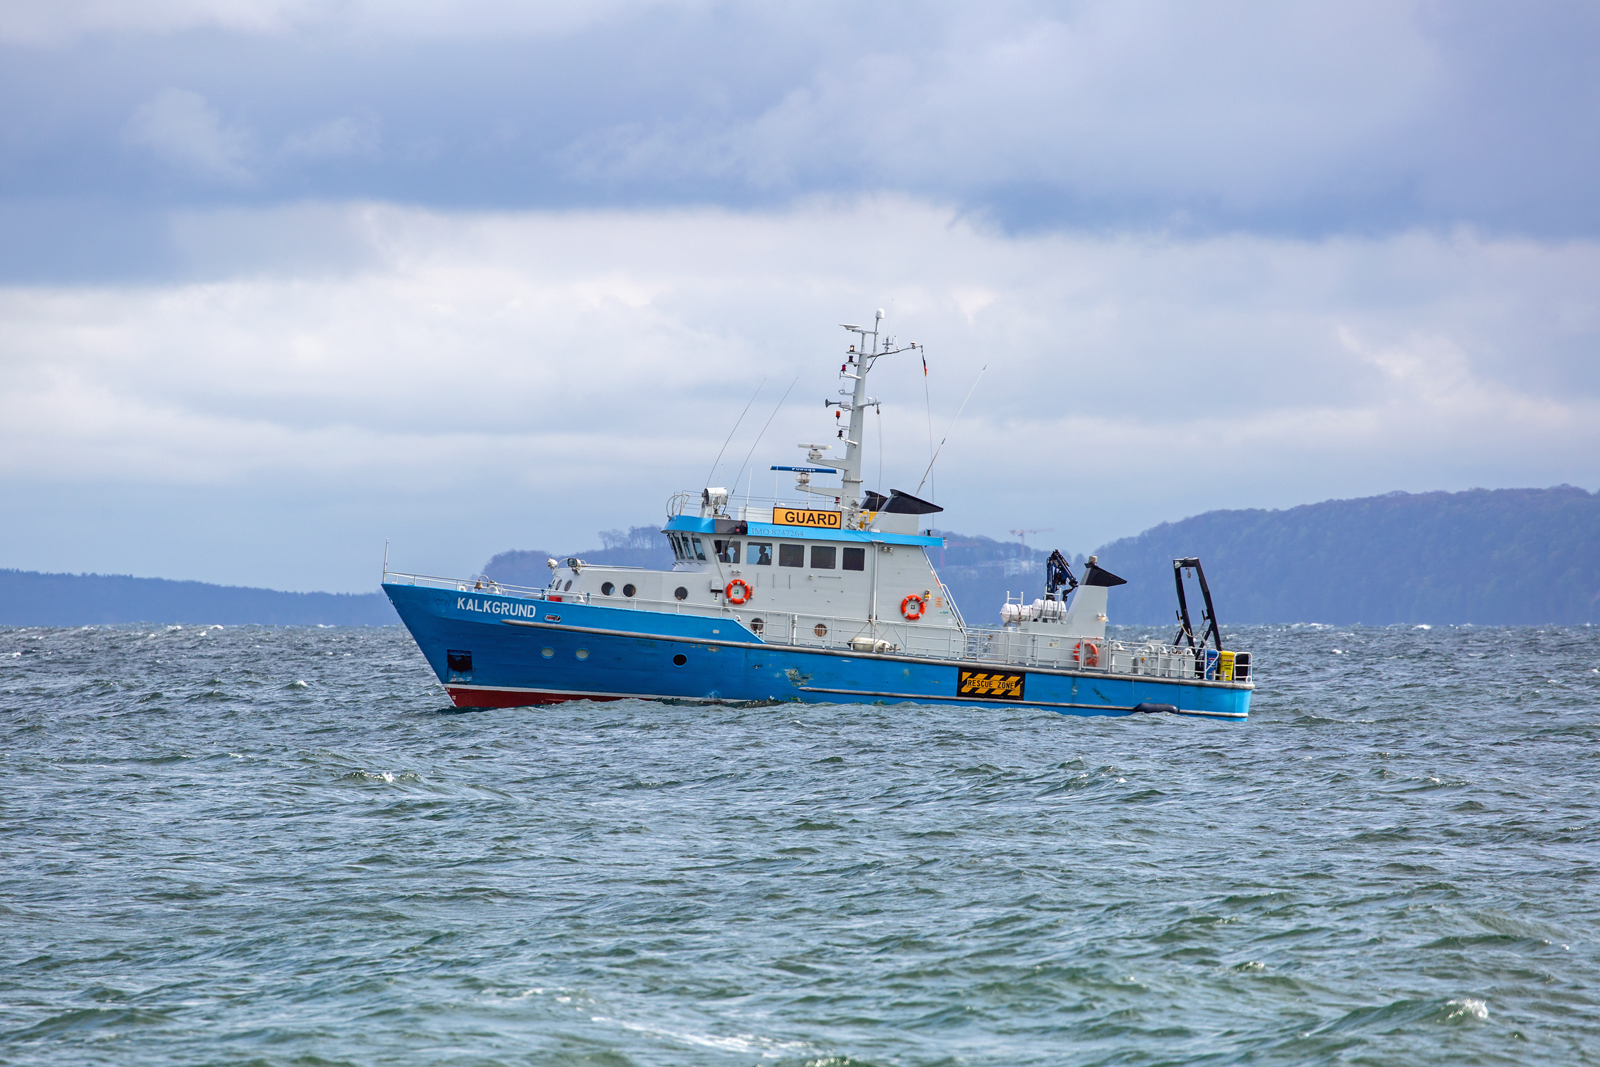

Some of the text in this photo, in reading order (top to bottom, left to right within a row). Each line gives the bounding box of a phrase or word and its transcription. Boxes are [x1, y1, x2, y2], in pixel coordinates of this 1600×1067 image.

[785, 511, 838, 526] GUARD
[751, 527, 804, 537] IMO 8747264
[457, 597, 536, 618] KALKGRUND
[967, 679, 1014, 690] RESCUE ZONE
